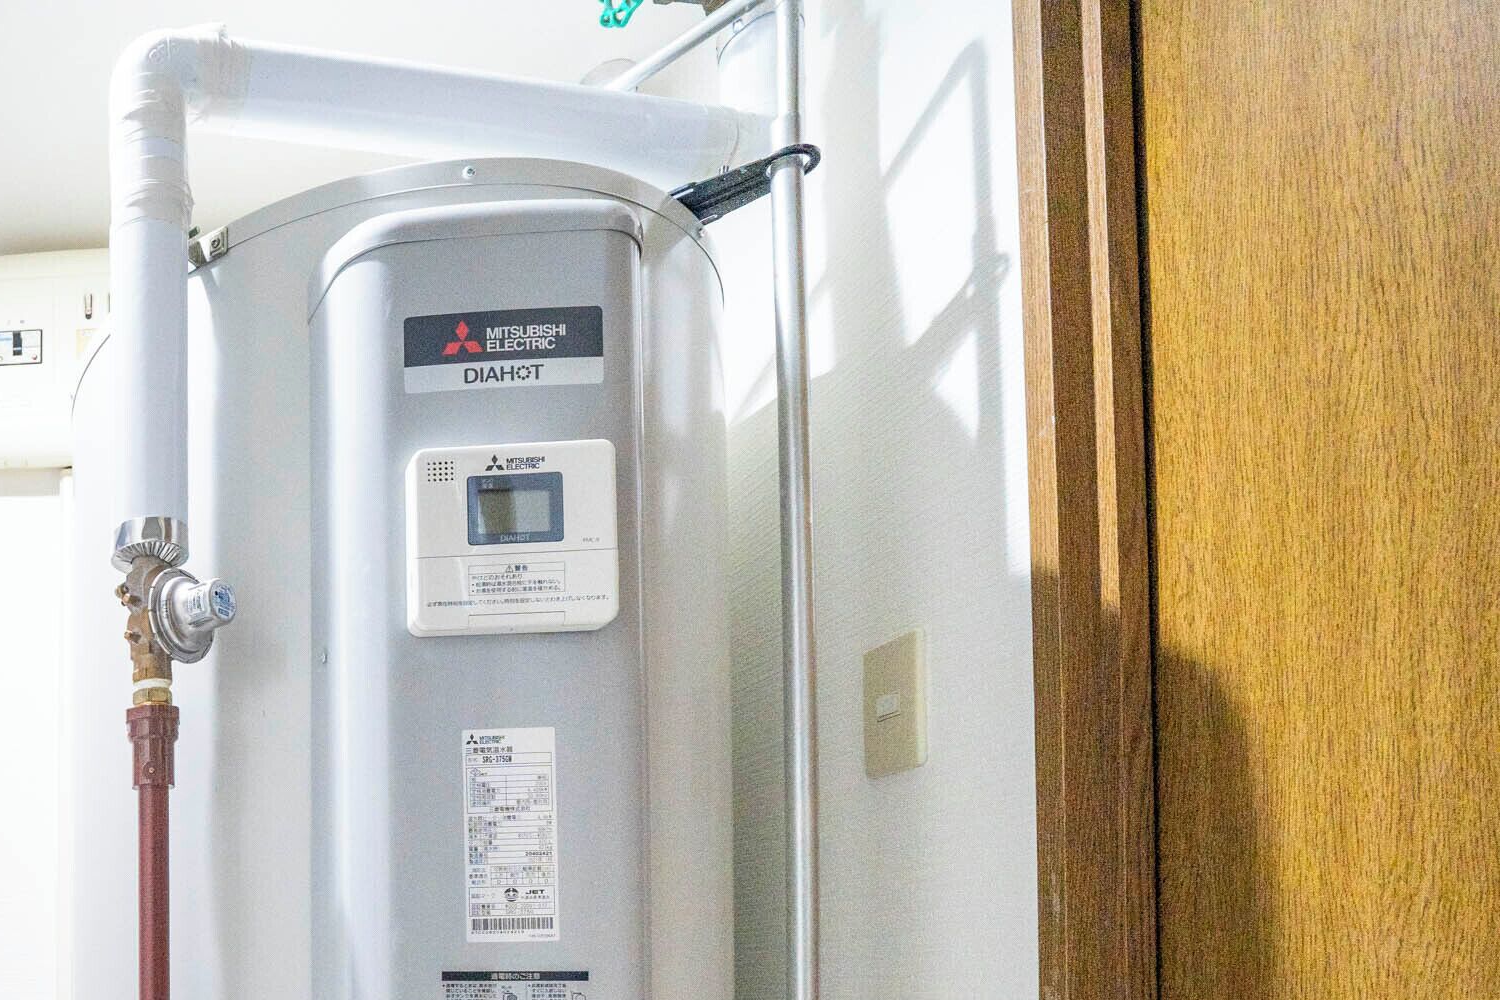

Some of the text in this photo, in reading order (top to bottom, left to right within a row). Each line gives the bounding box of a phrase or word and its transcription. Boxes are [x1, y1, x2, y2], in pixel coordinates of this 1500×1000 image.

[486, 323, 566, 339] MITSUBISHI
[486, 336, 556, 352] ELECTRIC
[464, 364, 544, 384] DIAHOT
[506, 456, 545, 464] MITSUBISHI
[506, 462, 540, 471] ELECTRIC
